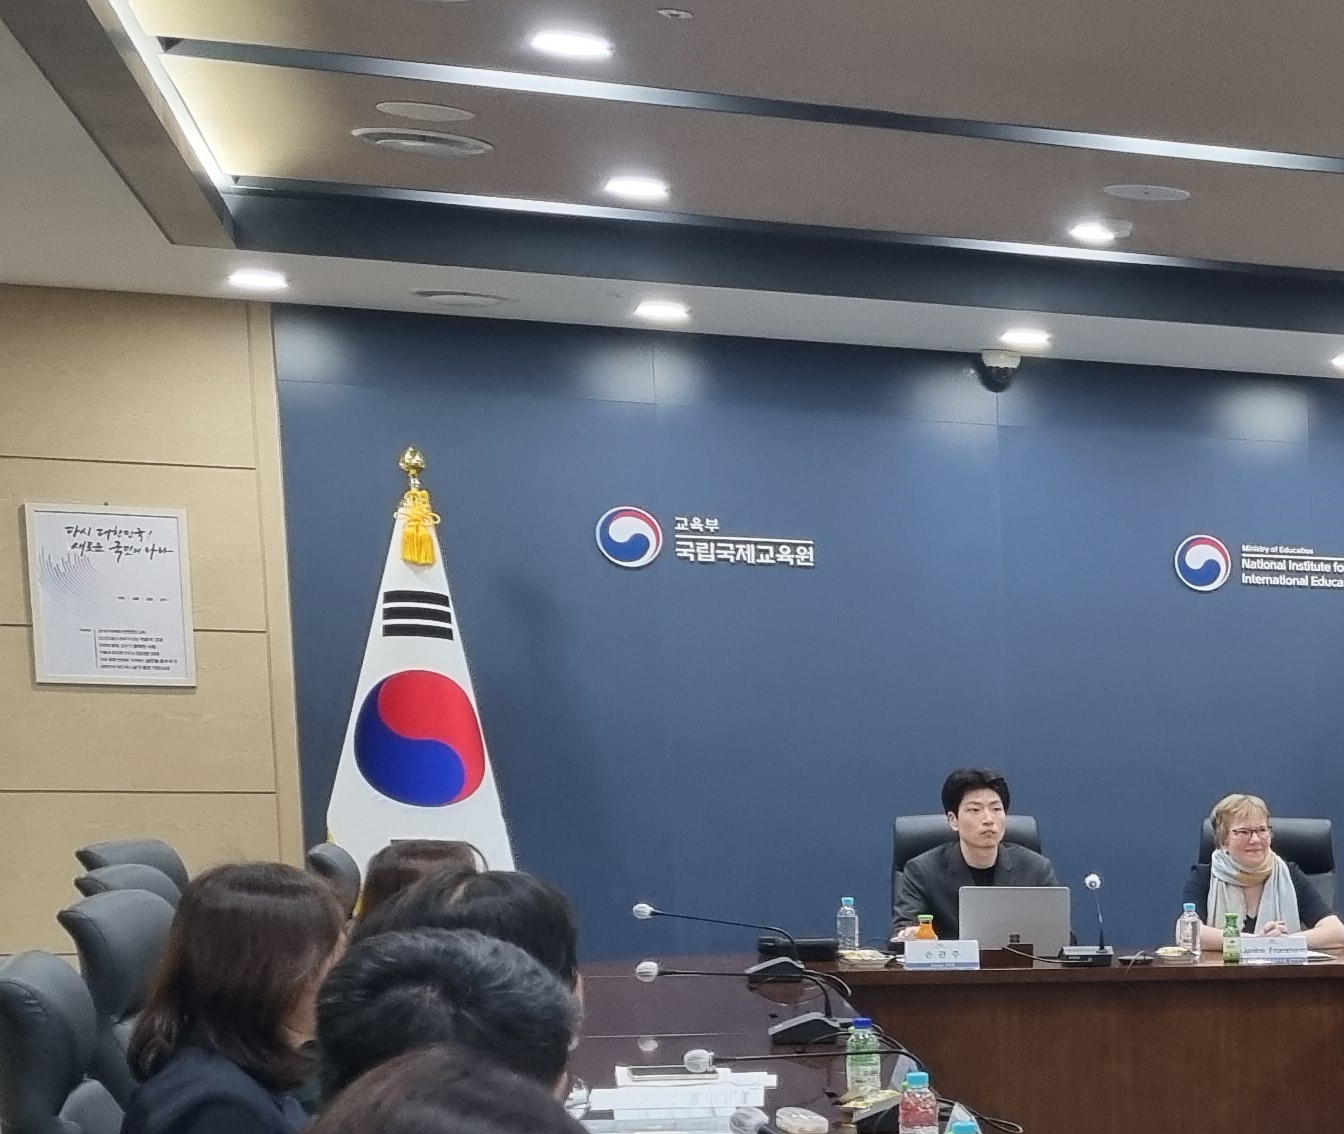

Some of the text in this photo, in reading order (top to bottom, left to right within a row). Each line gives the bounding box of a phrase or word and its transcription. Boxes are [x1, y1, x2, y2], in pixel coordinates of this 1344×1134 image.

[64, 524, 92, 538] 다시
[674, 516, 720, 533] 교육부
[71, 540, 105, 557] 새로운
[675, 540, 815, 567] 국립국제교육원
[1241, 544, 1269, 555] Ministry
[1279, 546, 1314, 555] Education
[1241, 558, 1287, 571] National
[1288, 560, 1332, 573] Institute
[1241, 572, 1309, 586] International
